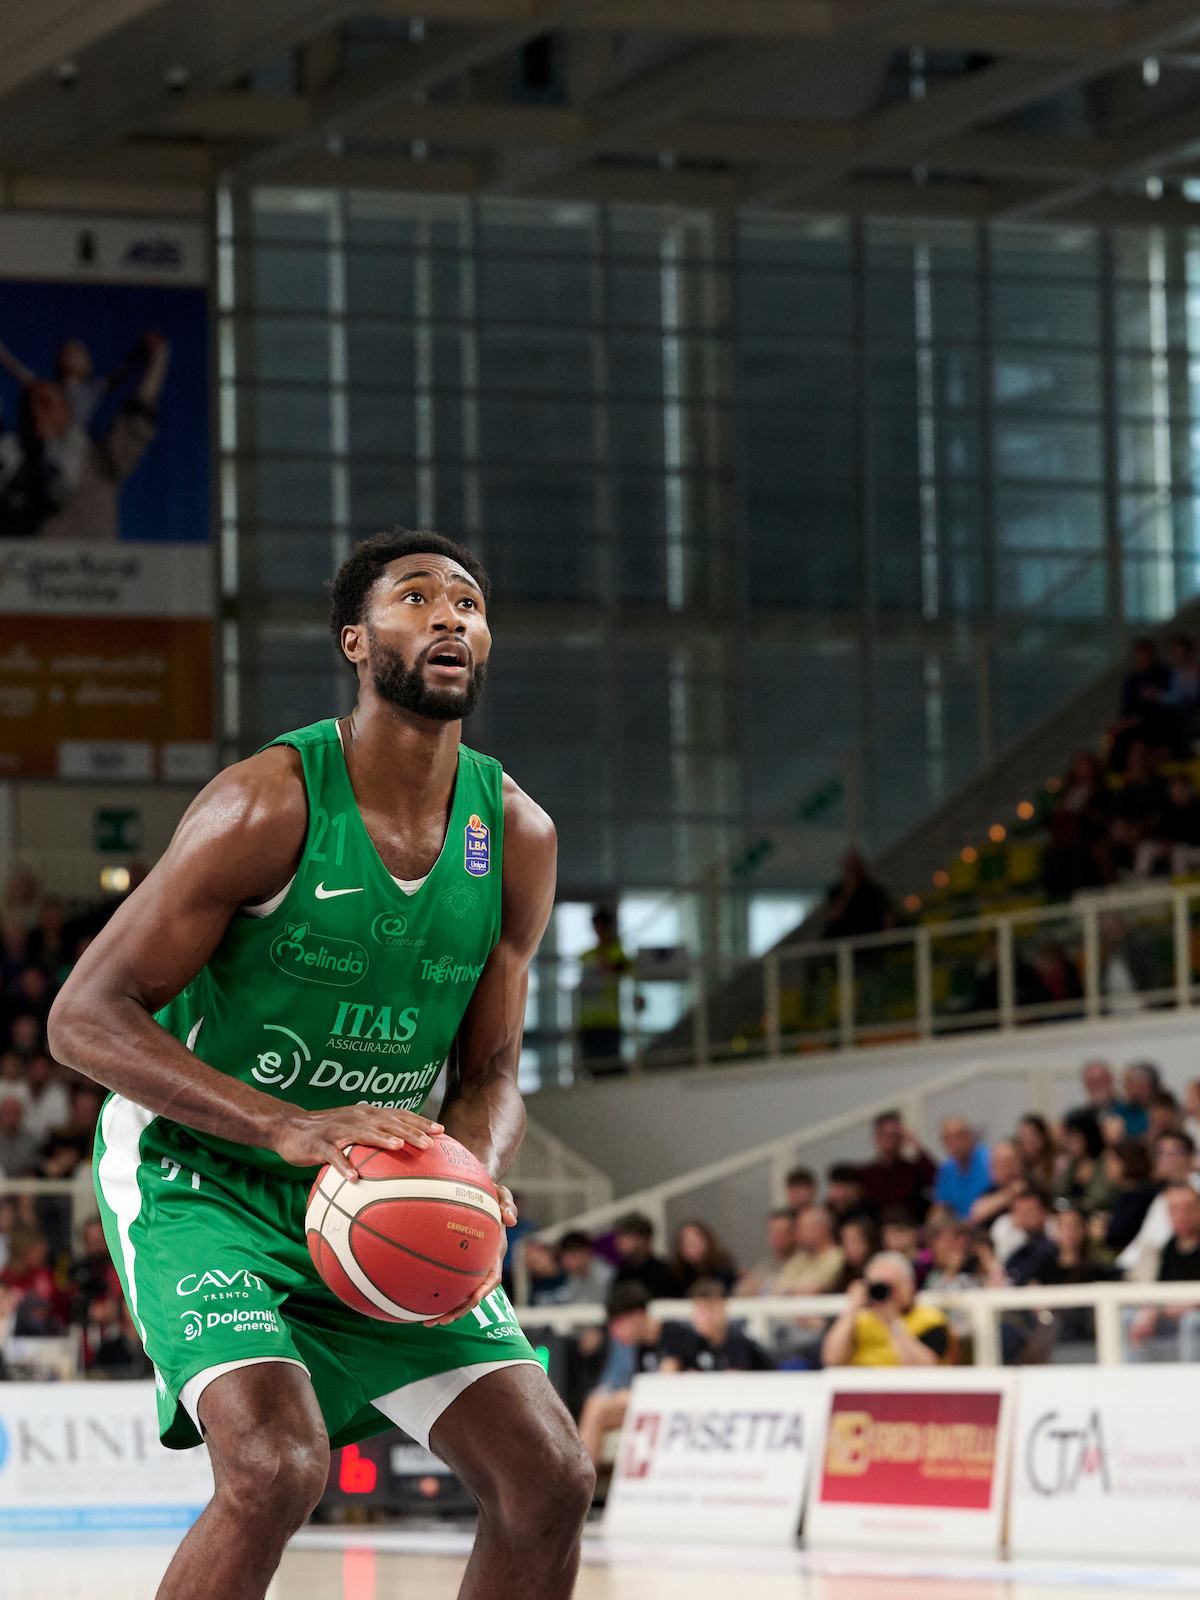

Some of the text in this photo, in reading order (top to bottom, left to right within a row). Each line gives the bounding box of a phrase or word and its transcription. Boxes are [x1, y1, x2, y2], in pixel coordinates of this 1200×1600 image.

[308, 807, 347, 866] 21
[468, 840, 487, 852] LBA
[386, 937, 427, 947] Corporate
[330, 1002, 419, 1041] ITAS
[326, 1038, 411, 1054] ASSICURAZIONI
[308, 1059, 440, 1094] Dolomiti
[356, 1092, 423, 1111] nergia
[176, 1269, 263, 1296] CAVIT
[203, 1292, 249, 1301] TRENTO
[207, 1309, 277, 1328] Dolomiti
[233, 1322, 279, 1333] energia
[664, 1411, 804, 1453] PISETTA
